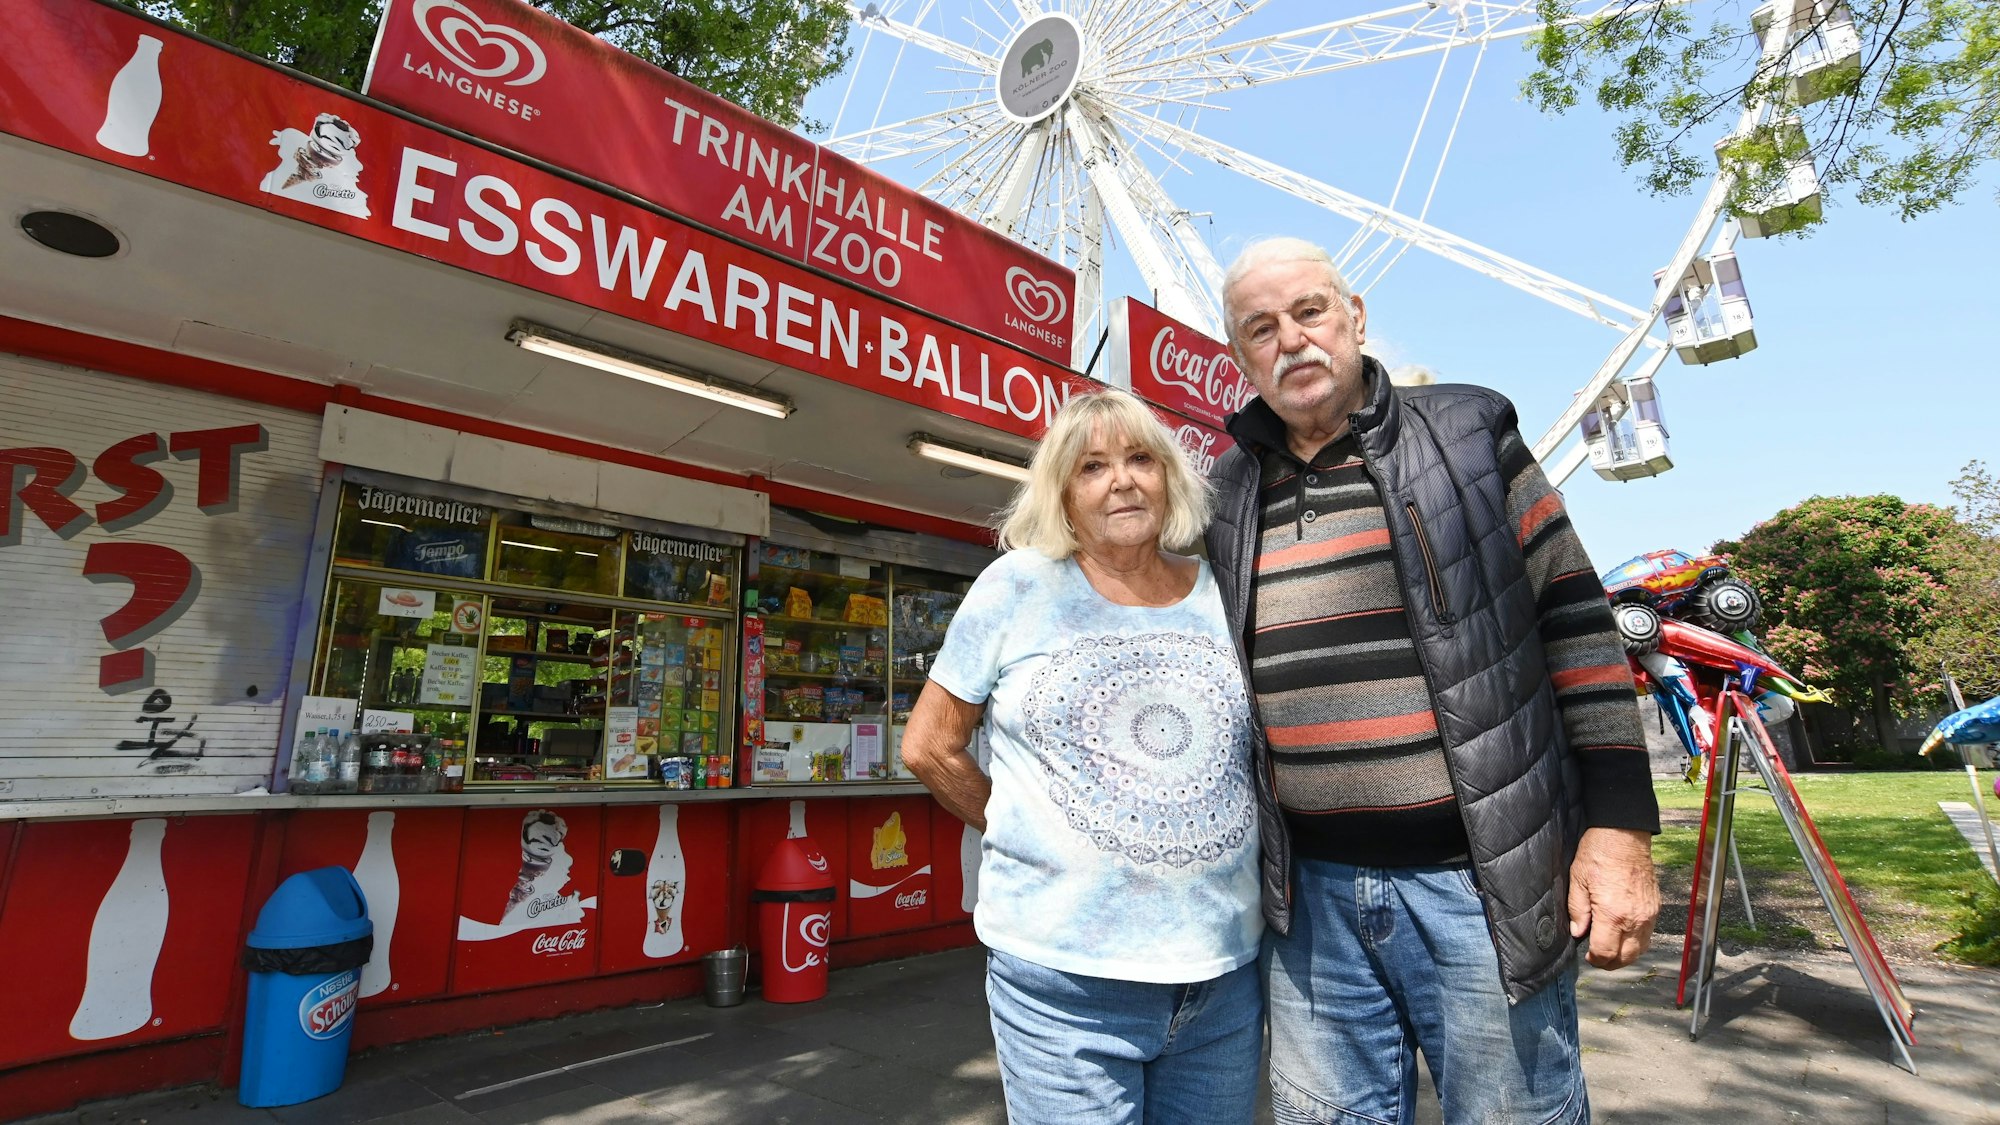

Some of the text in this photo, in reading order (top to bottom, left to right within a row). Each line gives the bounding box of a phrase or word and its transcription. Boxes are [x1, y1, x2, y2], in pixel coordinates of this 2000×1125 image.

[1049, 60, 1068, 74] ZOO
[402, 52, 533, 121] LANGNESE
[313, 183, 356, 199] Cornetto
[664, 97, 944, 262] TRINKHALLE
[720, 184, 901, 288] AM ZOO
[391, 146, 860, 369] ESSWAREN
[1004, 312, 1064, 349] LANGNESE
[358, 486, 483, 525] Jägermeister
[632, 531, 724, 562] Jägermeister
[527, 895, 568, 918] Cornetto
